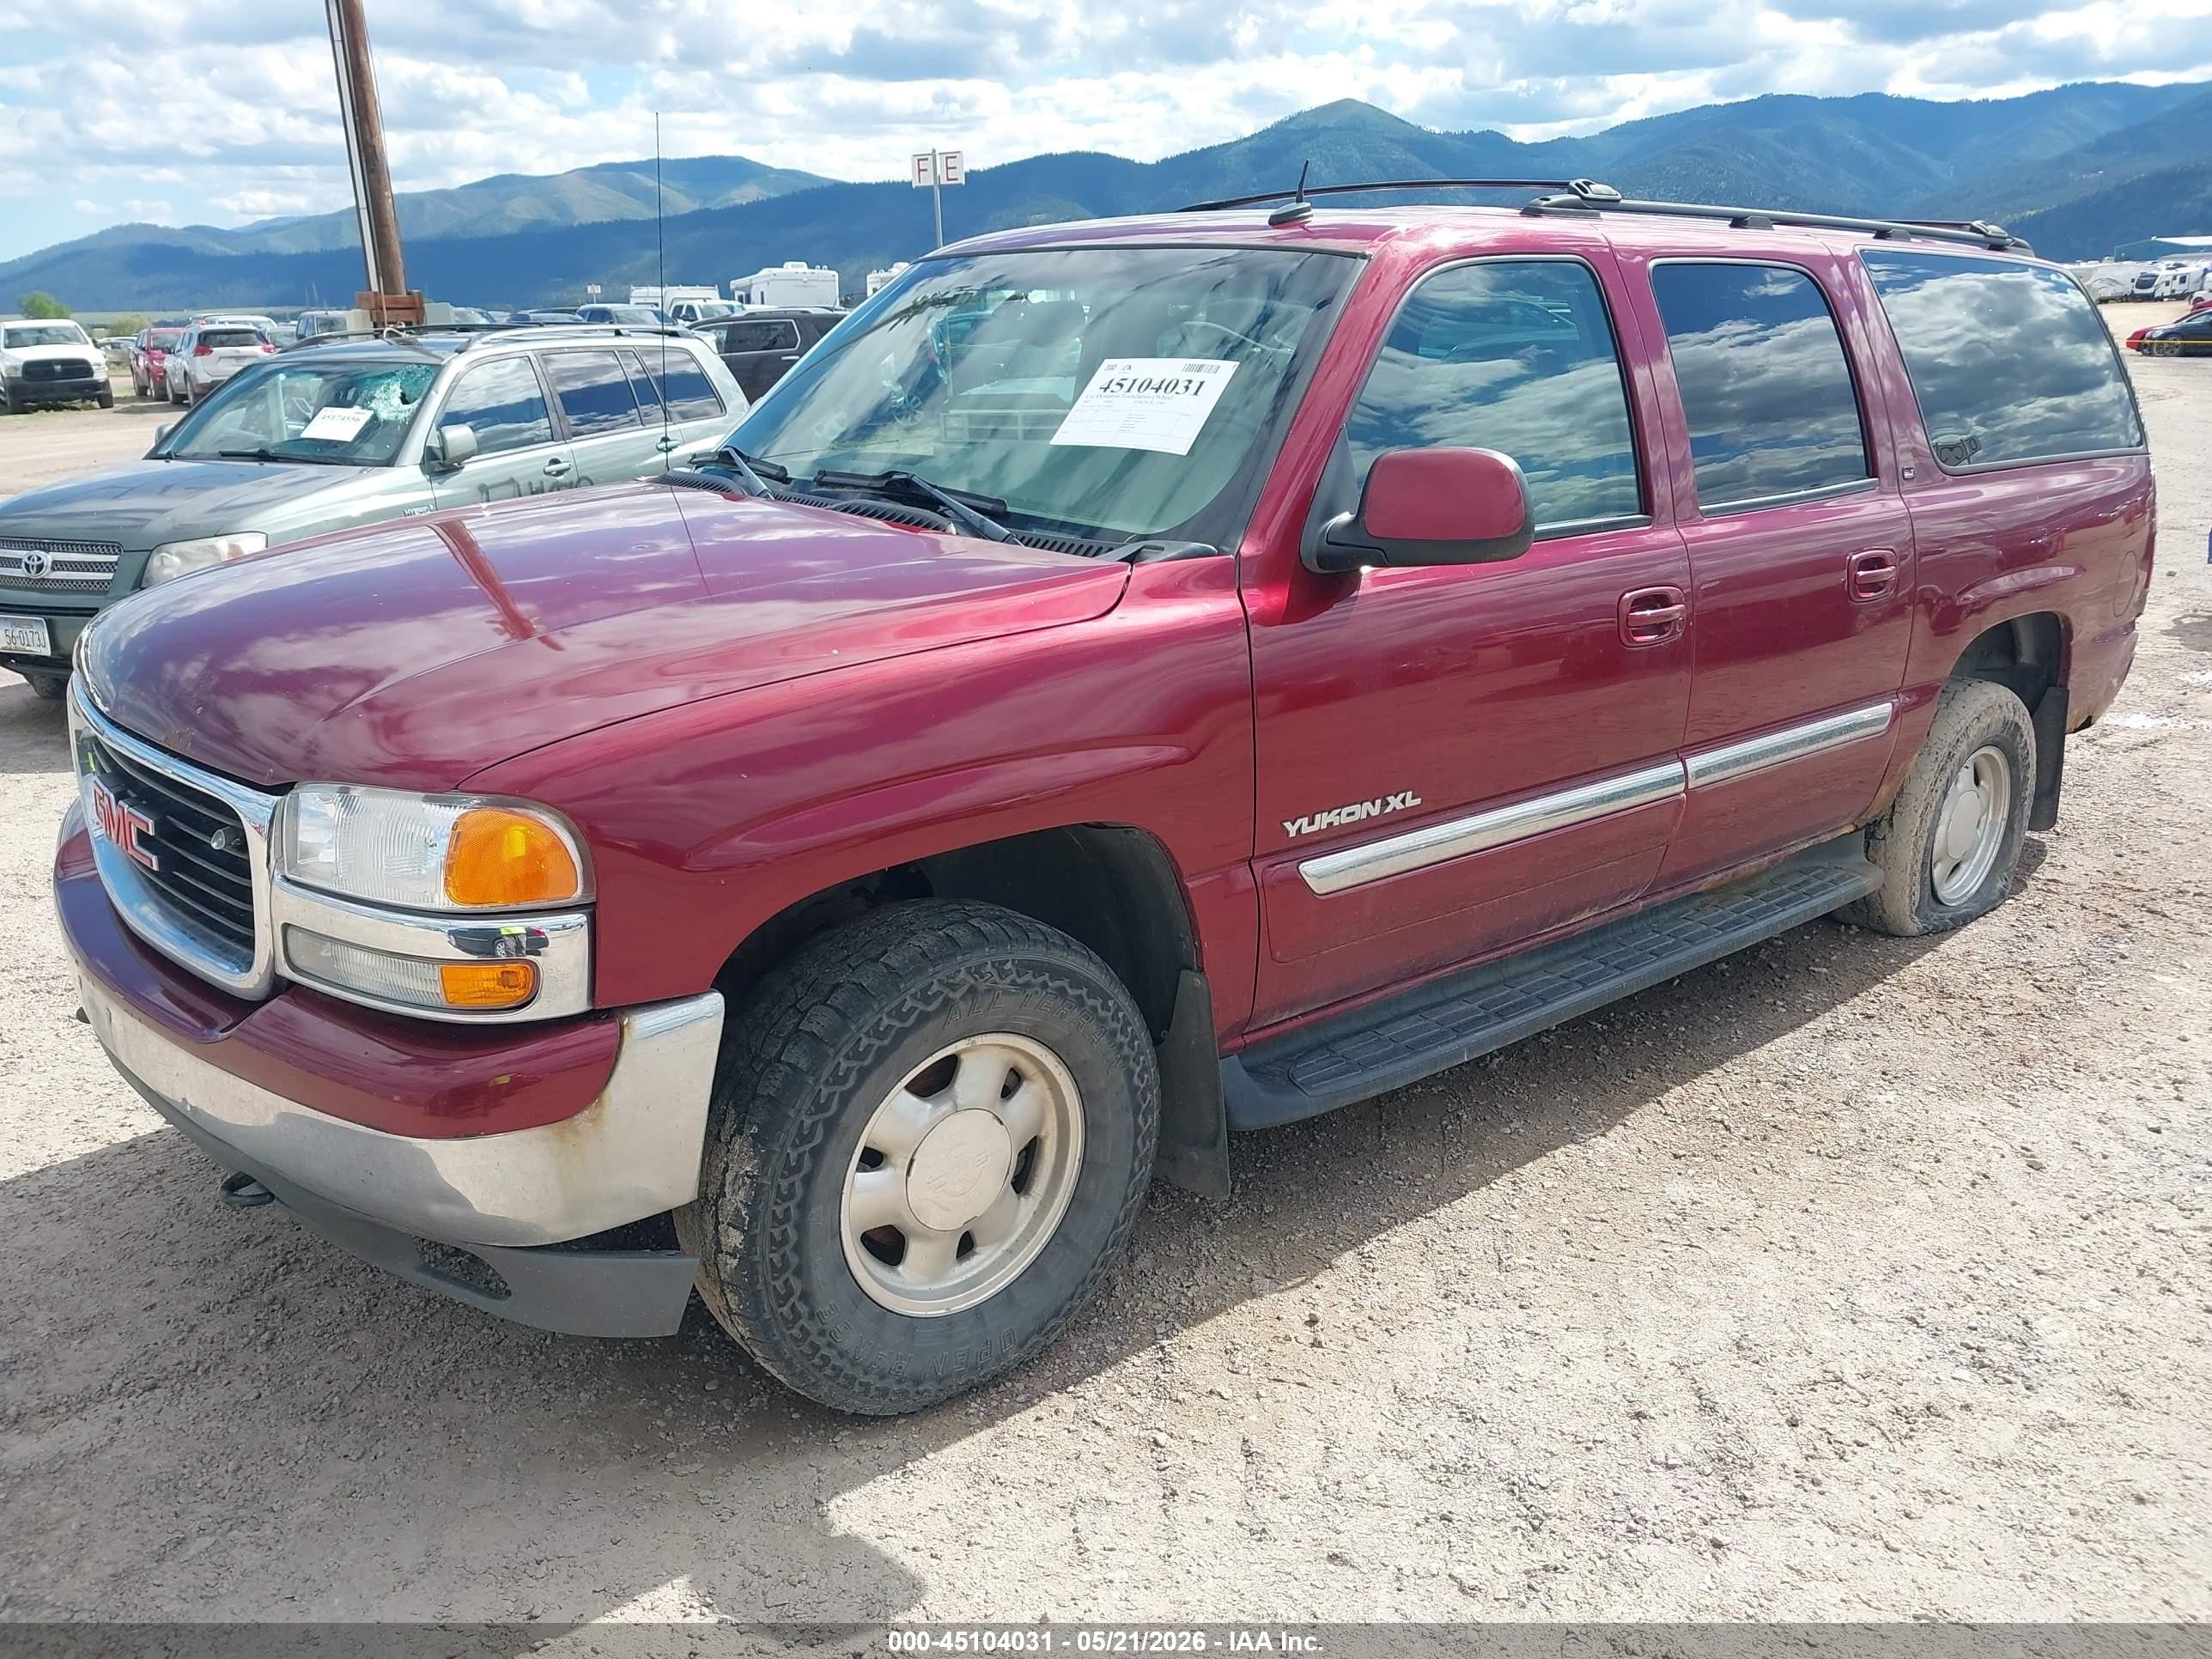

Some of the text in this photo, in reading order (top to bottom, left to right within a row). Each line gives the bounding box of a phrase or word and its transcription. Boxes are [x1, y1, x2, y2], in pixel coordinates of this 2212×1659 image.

[916, 157, 929, 184] F
[945, 155, 959, 182] E
[1099, 377, 1206, 397] 45104031
[92, 777, 160, 872] GMC
[1283, 790, 1422, 838] YUKON XL
[943, 989, 1004, 1030] ALL
[816, 1300, 1018, 1377] OPEN RANGE
